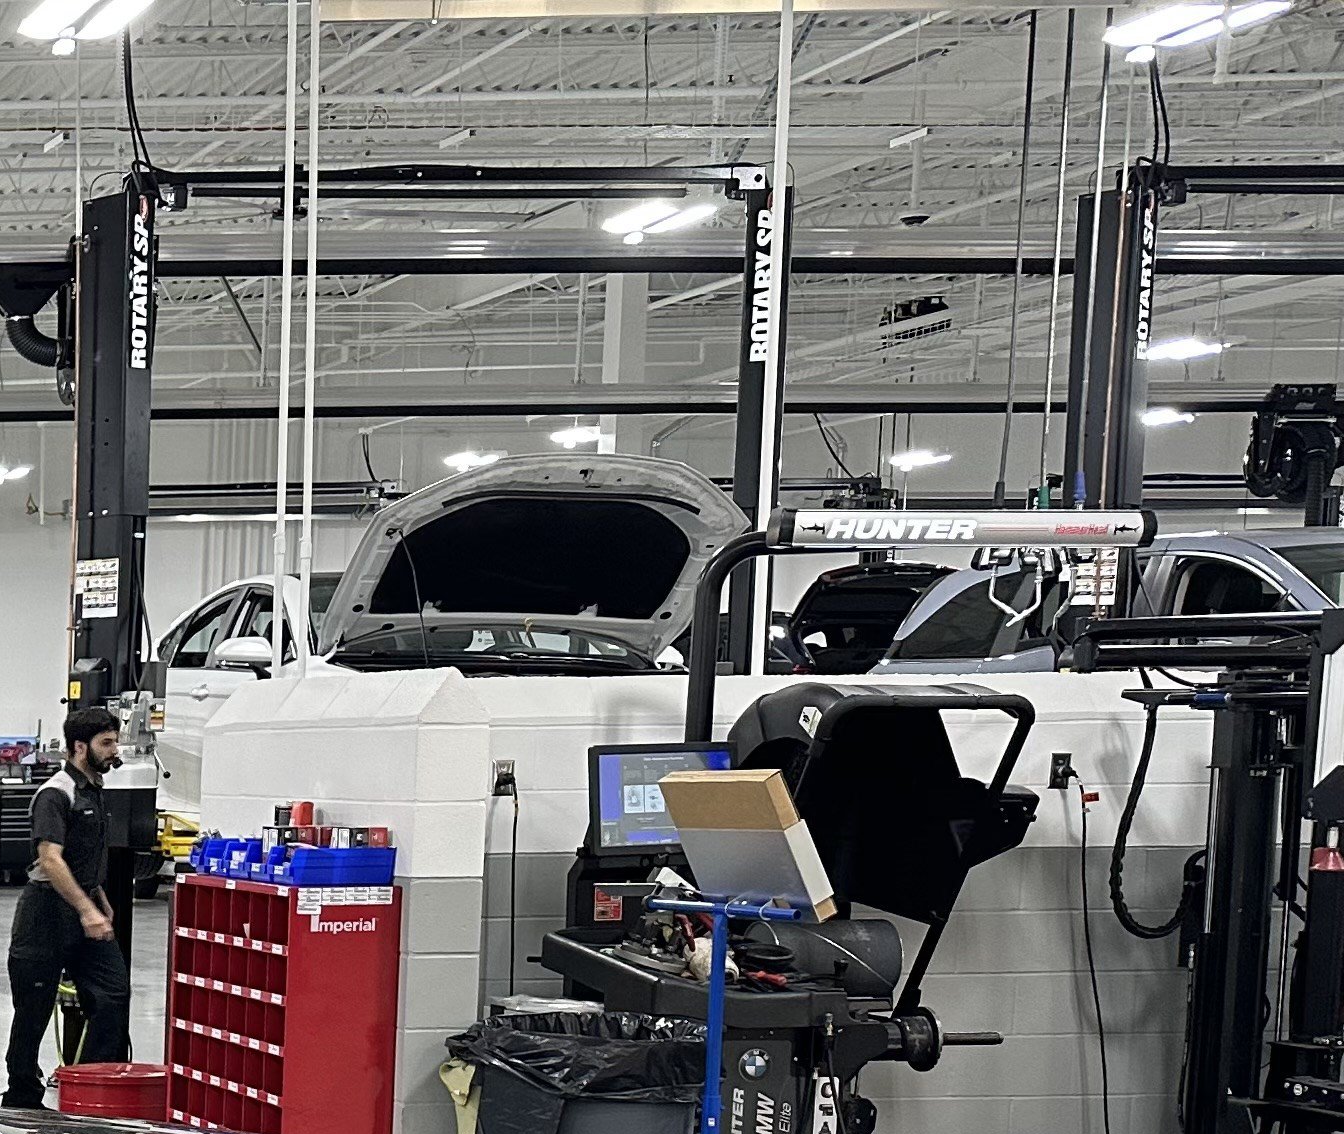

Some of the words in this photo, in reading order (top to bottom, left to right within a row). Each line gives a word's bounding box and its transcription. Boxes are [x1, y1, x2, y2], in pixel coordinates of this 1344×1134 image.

[134, 213, 149, 256] SP
[131, 255, 148, 369] ROTARY
[749, 251, 772, 362] ROTARY
[1137, 249, 1152, 360] ROTARY
[826, 518, 979, 540] HUNTER
[310, 914, 376, 935] Imperial
[778, 1102, 792, 1133] Elite
